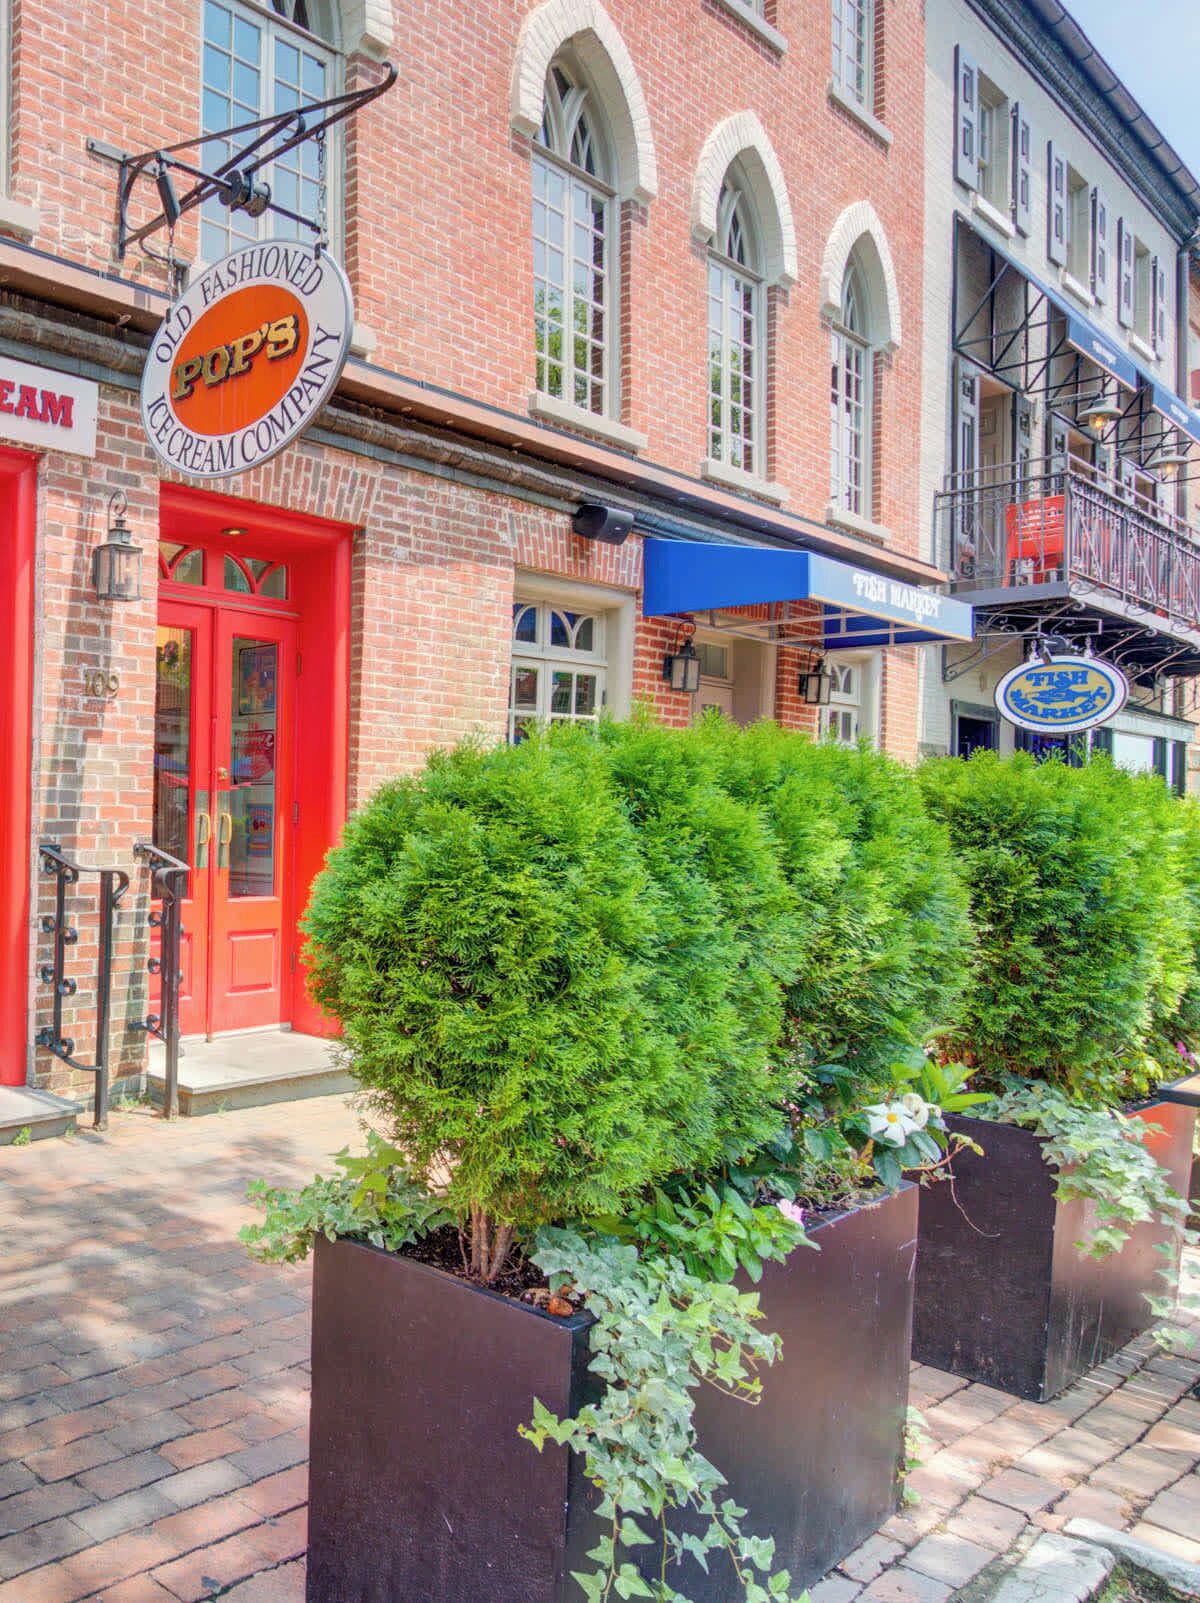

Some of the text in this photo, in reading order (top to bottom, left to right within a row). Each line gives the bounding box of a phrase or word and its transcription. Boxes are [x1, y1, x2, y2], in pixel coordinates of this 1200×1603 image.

[155, 246, 323, 363] OLD FASHIONED
[173, 315, 299, 401] POP'S
[147, 323, 341, 473] ICE CREAM COMPANY
[853, 572, 887, 603] FISH
[83, 670, 120, 699] 109
[1025, 670, 1089, 689] FISH
[1009, 686, 1108, 720] MARKET
